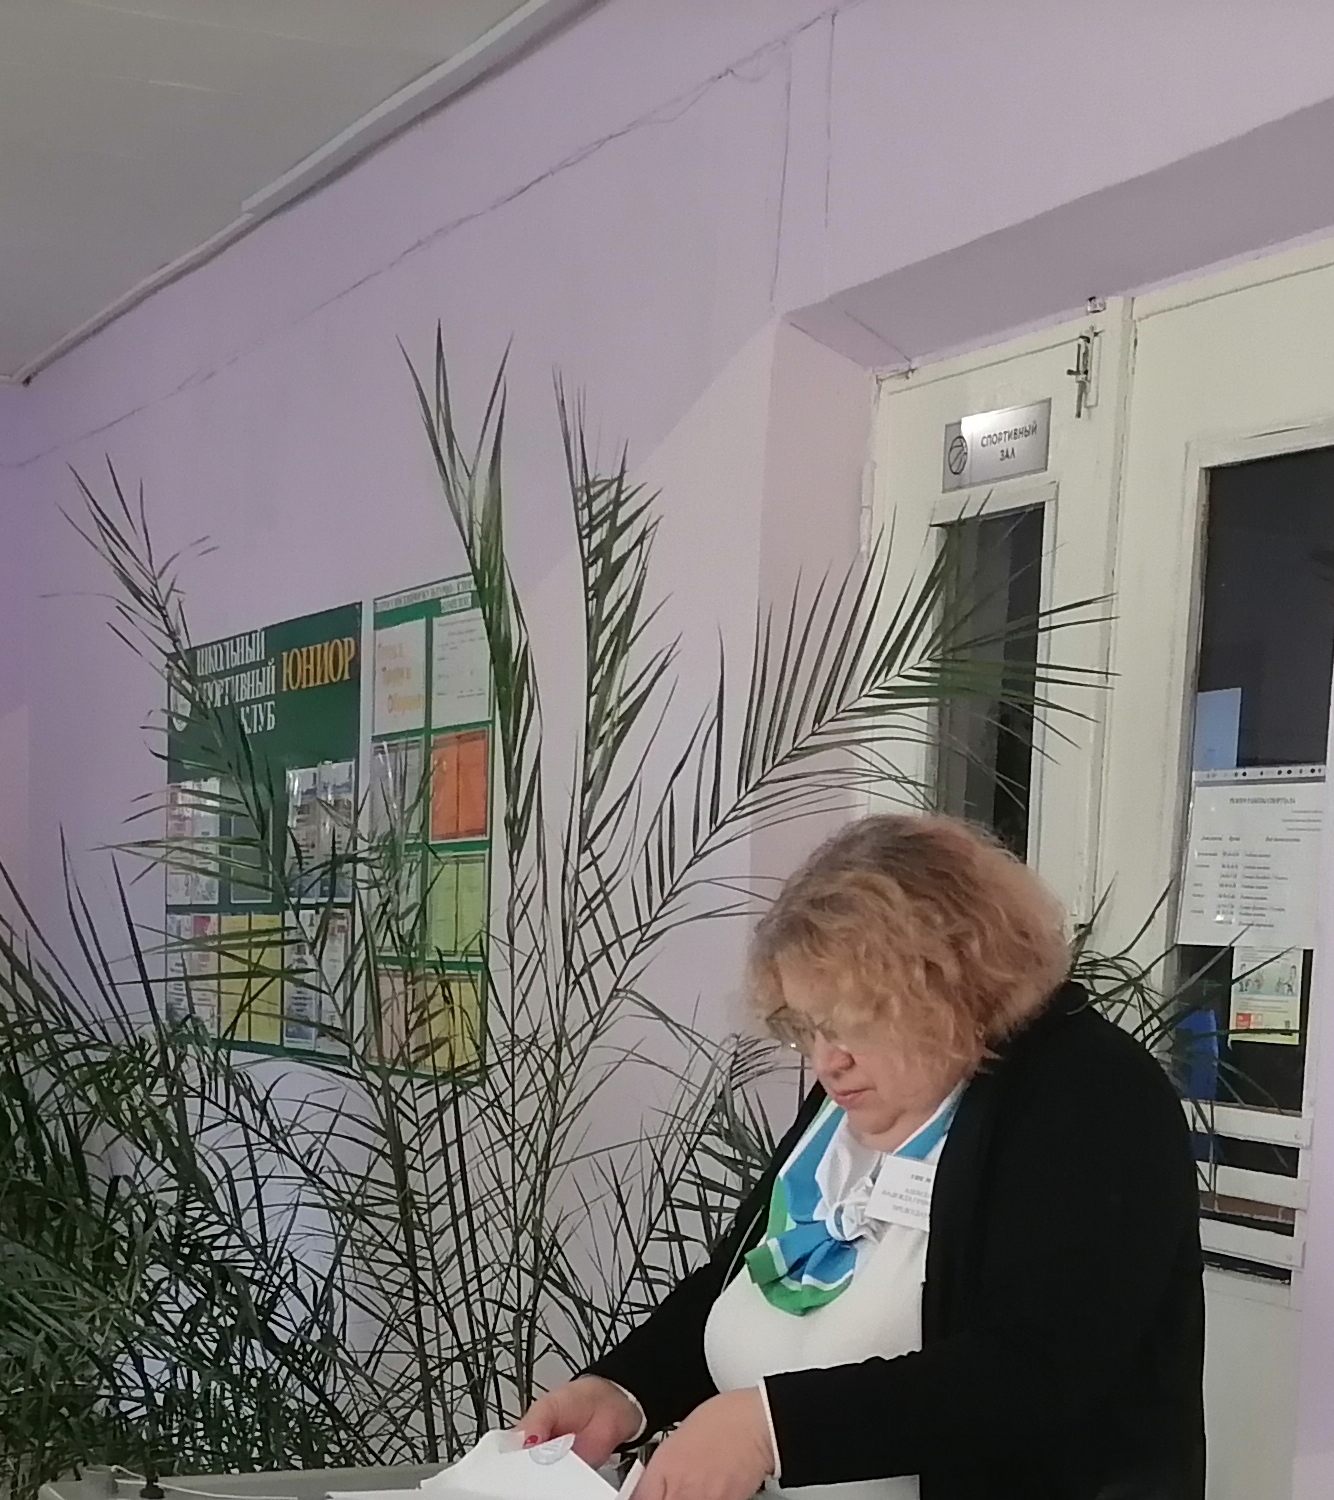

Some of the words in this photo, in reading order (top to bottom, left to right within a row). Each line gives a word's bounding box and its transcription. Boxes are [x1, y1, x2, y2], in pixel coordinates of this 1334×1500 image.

[981, 419, 1037, 447] СПОРТИВНЫЙ
[1000, 447, 1015, 461] ЗАЛ
[196, 628, 265, 677] ШКОЛЬНЫЙ
[282, 637, 356, 691] ЮНИОР
